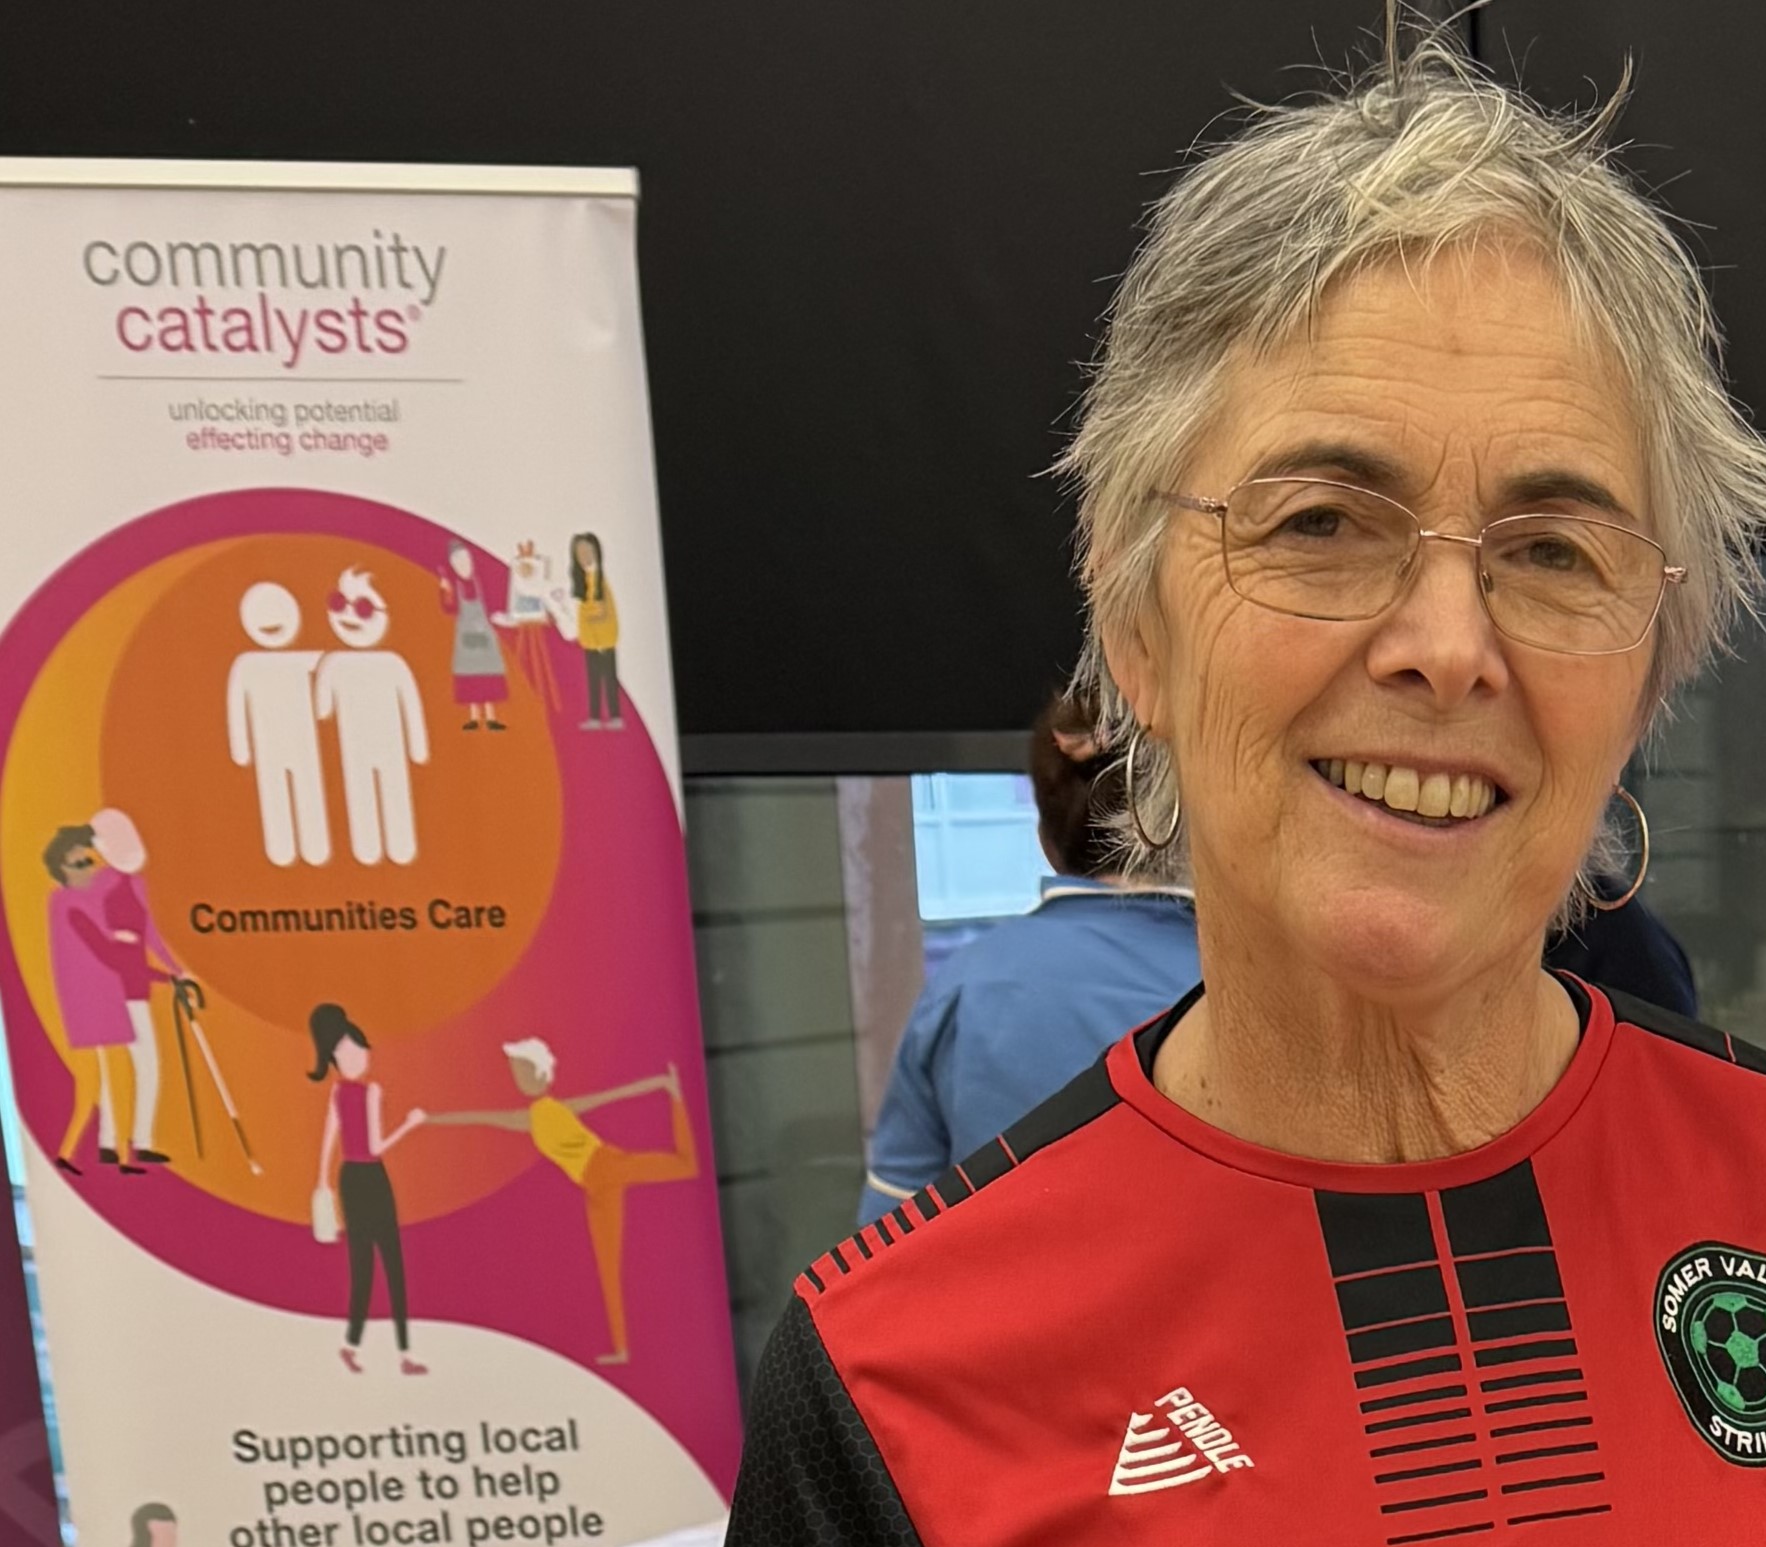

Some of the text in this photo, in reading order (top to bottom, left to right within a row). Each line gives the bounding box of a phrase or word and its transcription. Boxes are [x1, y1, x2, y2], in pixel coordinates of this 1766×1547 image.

[83, 230, 446, 305] community
[169, 398, 399, 427] unlocking potential
[187, 428, 389, 456] effecting change
[190, 901, 506, 934] Communities Care
[1662, 1254, 1714, 1334] SOMER
[232, 1420, 580, 1466] Supporting local
[1154, 1387, 1255, 1473] PENDLE
[263, 1464, 560, 1510] people to help
[353, 1512, 451, 1547] local
